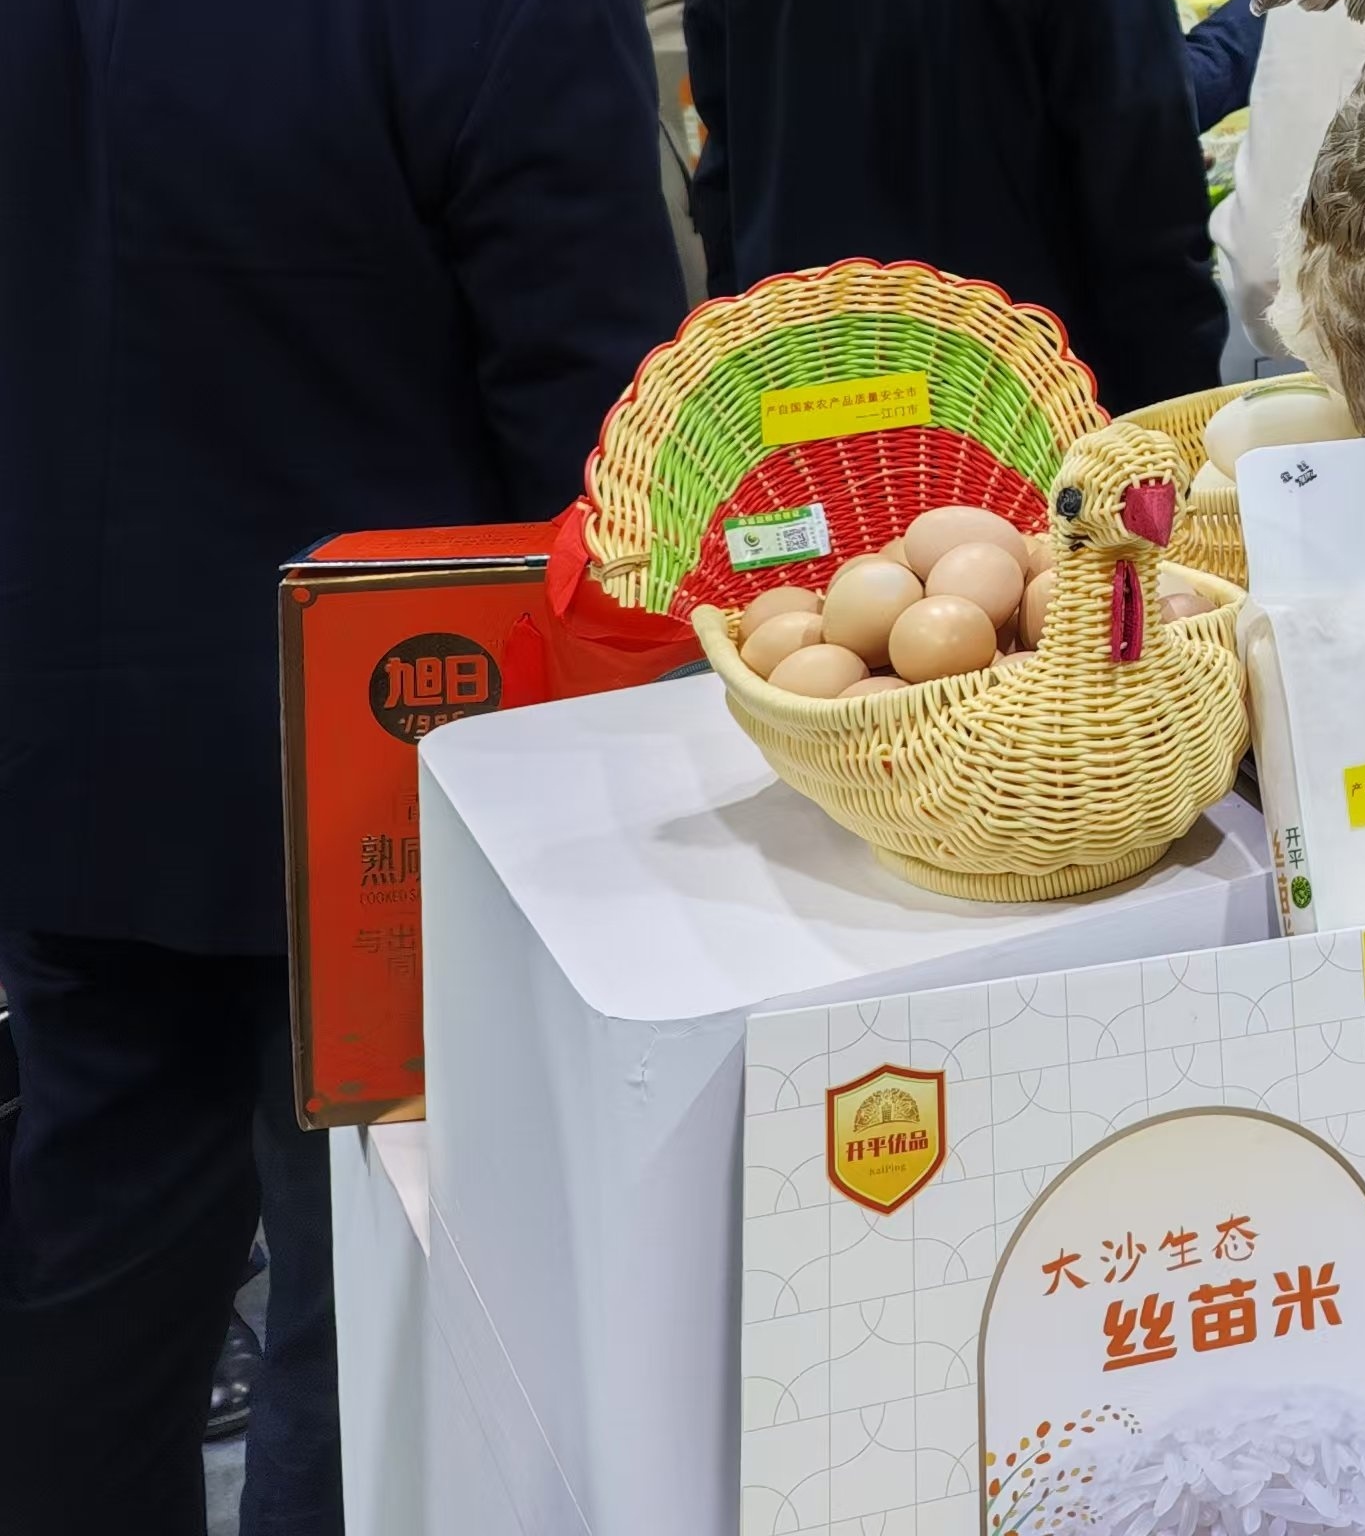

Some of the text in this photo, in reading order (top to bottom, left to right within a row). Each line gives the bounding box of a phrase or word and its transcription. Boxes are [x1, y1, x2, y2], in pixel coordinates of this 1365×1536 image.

[765, 386, 918, 417] 产自国家农产品质量安全市
[382, 652, 490, 711] 旭日
[1284, 825, 1305, 870] 开平
[845, 1129, 929, 1163] 开平优品
[1041, 1212, 1262, 1297] 大沙生态
[1101, 1260, 1346, 1375] 丝苗米
